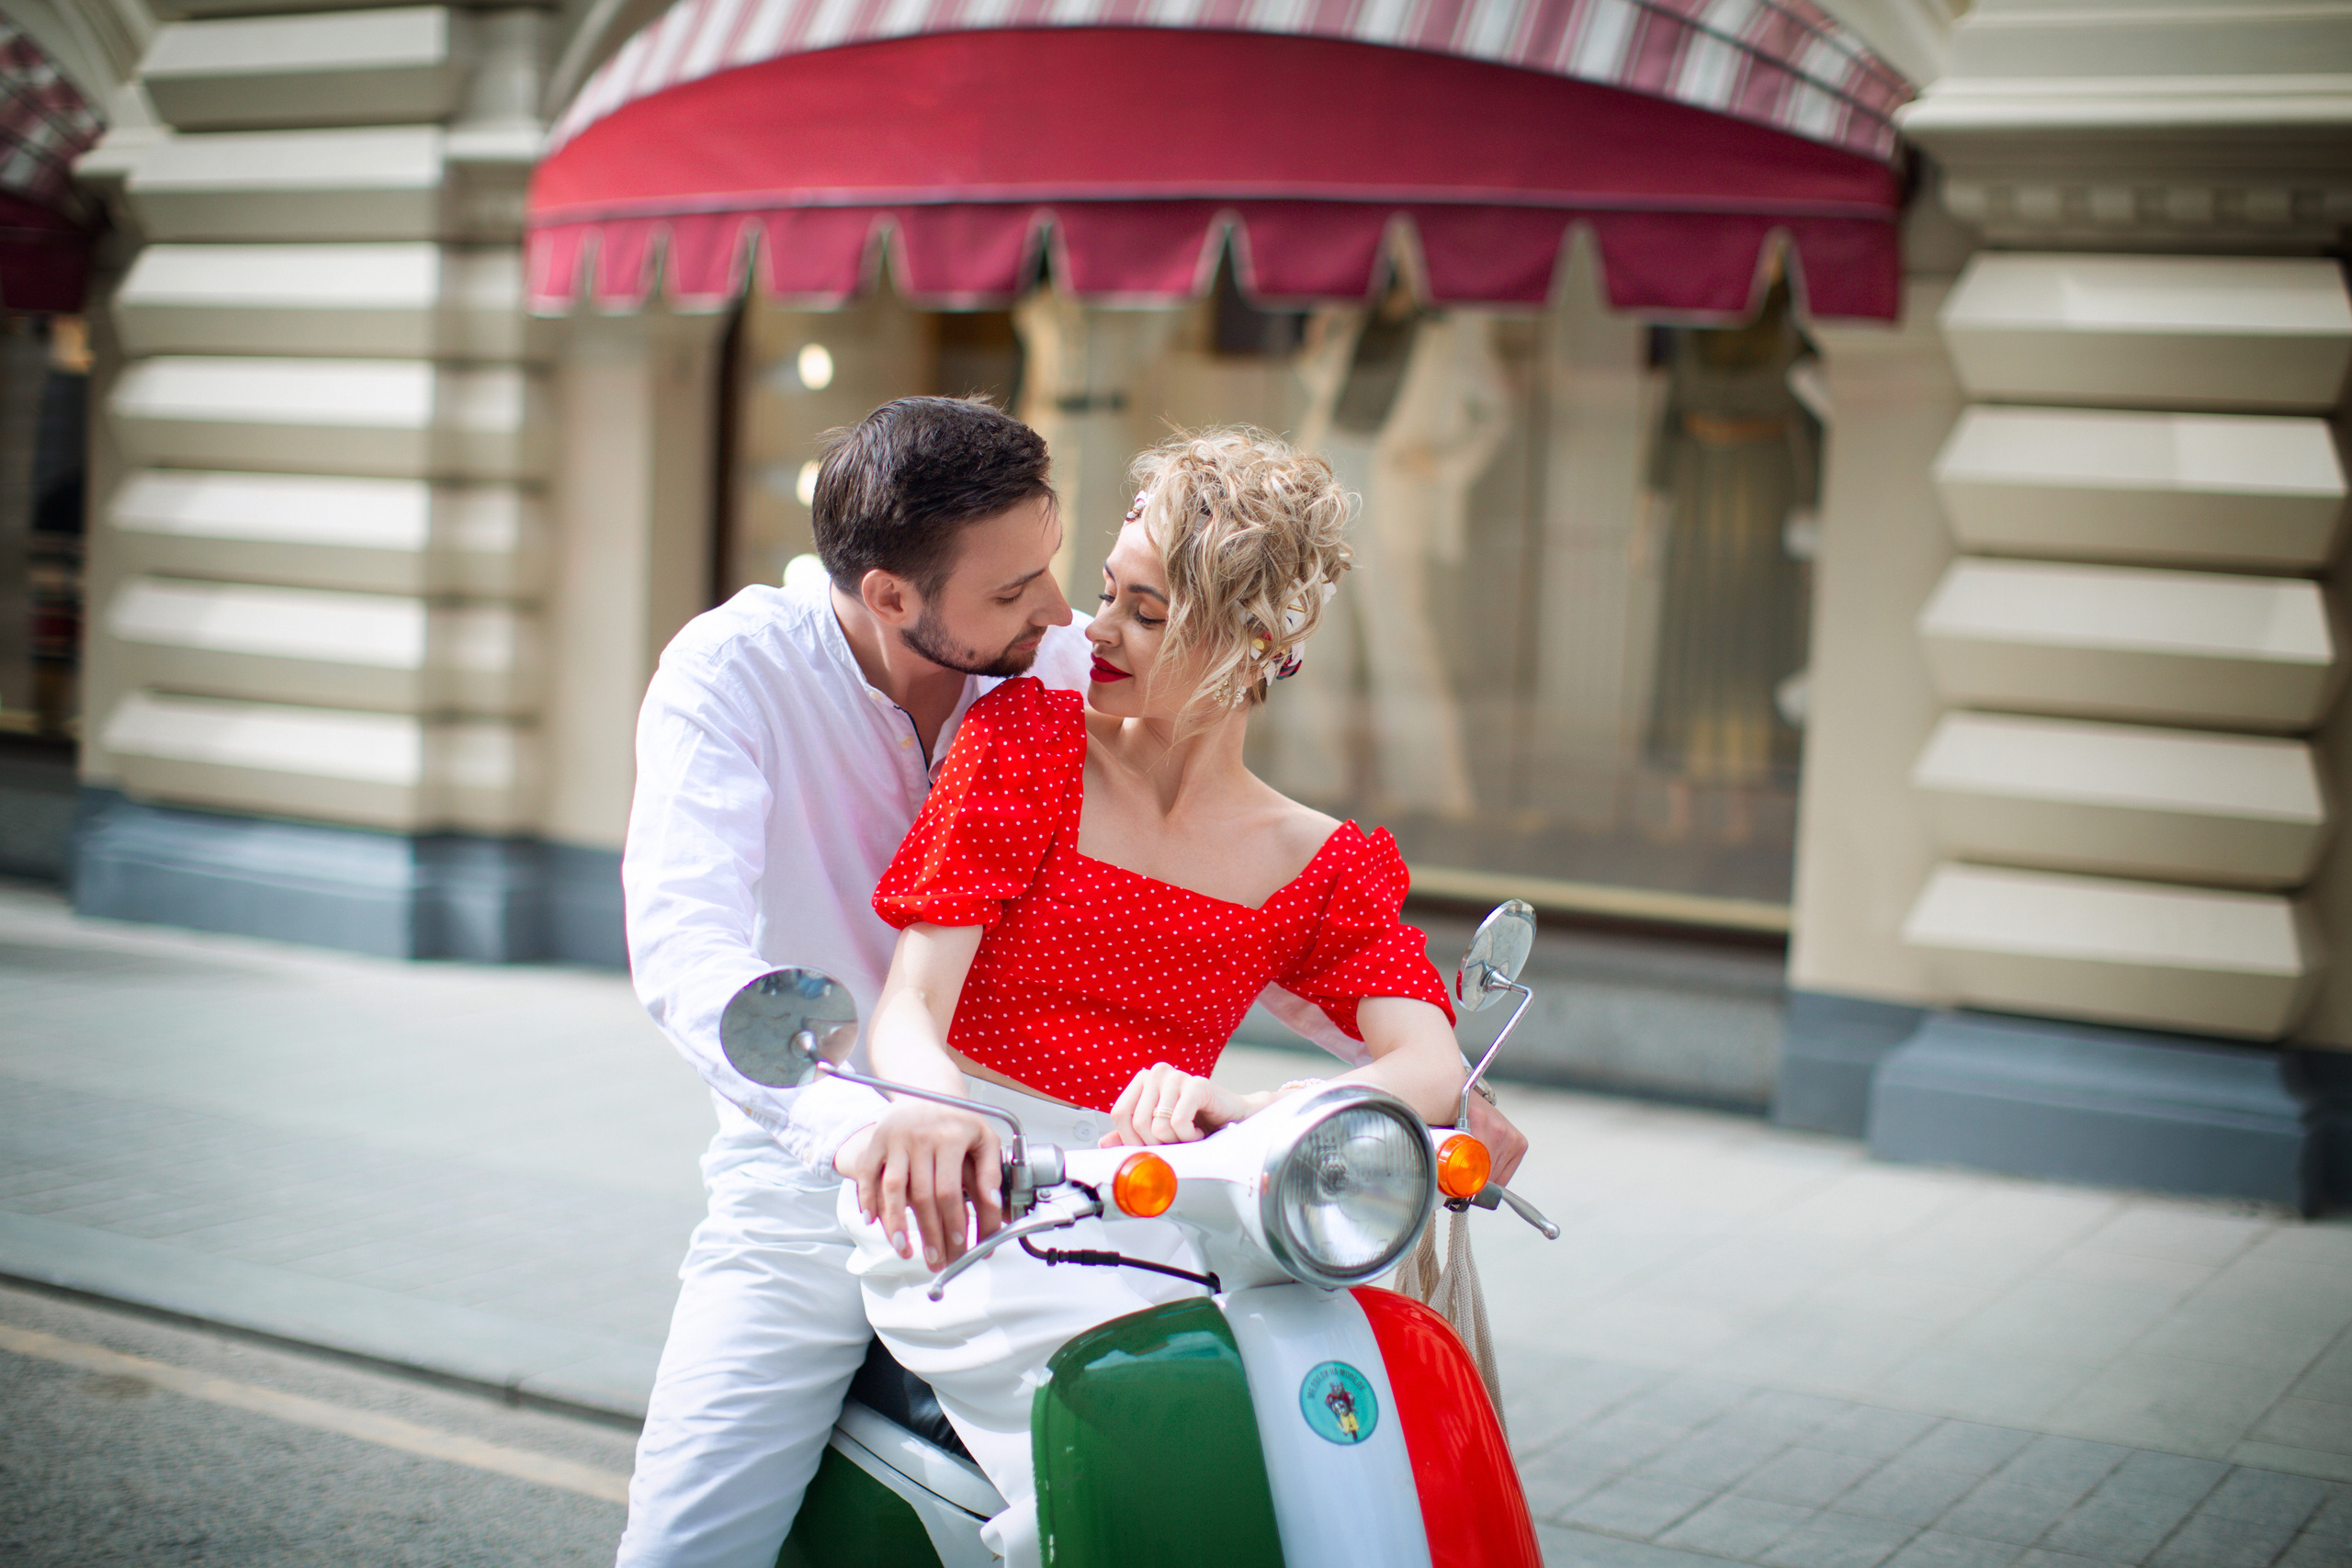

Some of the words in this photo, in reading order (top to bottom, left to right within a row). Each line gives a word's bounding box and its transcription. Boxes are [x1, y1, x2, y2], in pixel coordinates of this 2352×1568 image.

[1307, 1369, 1329, 1398] МЕДВЕДИ
[1329, 1368, 1339, 1376] НА
[1340, 1368, 1366, 1392] МОПЕДЕ
